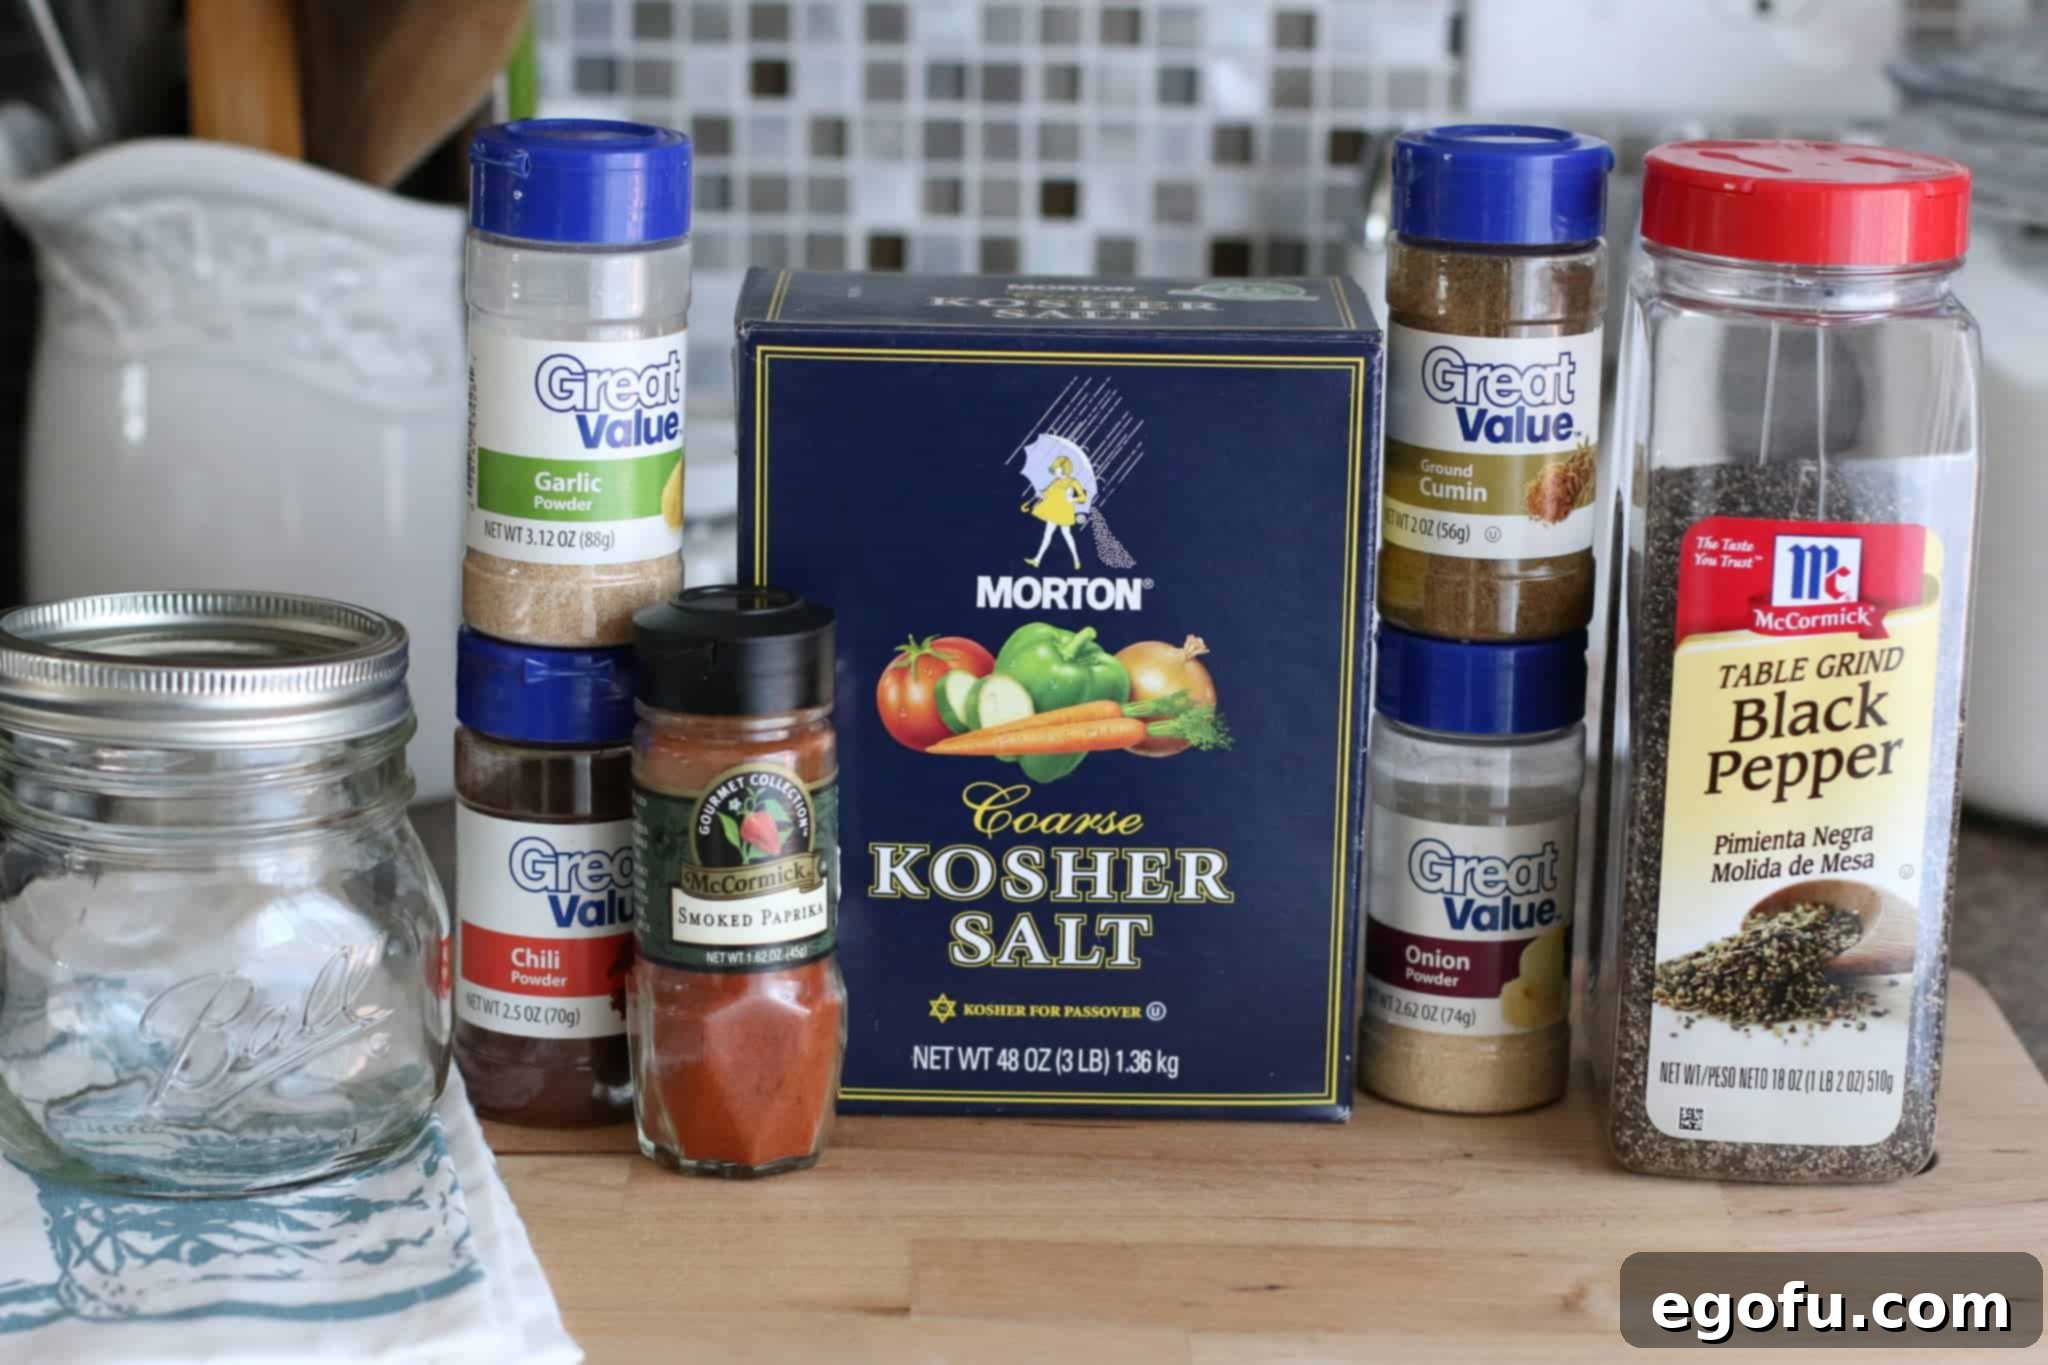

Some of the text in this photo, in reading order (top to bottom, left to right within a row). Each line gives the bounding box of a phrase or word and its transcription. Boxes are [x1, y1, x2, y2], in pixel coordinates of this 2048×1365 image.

[931, 296, 1225, 311] KOSHER
[992, 308, 1161, 320] SALT
[535, 350, 680, 412] Great
[1422, 346, 1576, 407] Great
[576, 409, 680, 449] Value
[1456, 406, 1575, 444] Value
[534, 471, 603, 493] Garlic
[1420, 459, 1473, 479] Ground
[533, 496, 593, 511] Powder
[1420, 477, 1487, 502] Cumin
[484, 520, 615, 550] NET WT 3.12 OZ (88g)
[1410, 515, 1417, 533] 2
[1419, 518, 1434, 536] OZ
[1437, 520, 1470, 544] (56g)
[1696, 536, 1754, 552] The Taste
[1694, 553, 1717, 566] You
[1753, 606, 1871, 631] McCormick
[1719, 646, 1905, 689] TABLE GRIND
[1729, 681, 1889, 743] Black
[1704, 738, 1903, 803] Pepper
[699, 776, 745, 835] GOURMET
[962, 781, 1145, 839] Coarse
[1713, 825, 1874, 855] Pimienta Negra
[509, 836, 634, 893] Grea
[868, 842, 1234, 903] KOSHER
[1408, 838, 1558, 898] Great
[1710, 852, 1874, 883] Molida de Mesa
[547, 890, 634, 928] Valu
[678, 902, 824, 927] SMOKED PAPRIKA
[1443, 896, 1557, 932] Value
[948, 910, 1153, 969] SALT
[511, 947, 560, 969] Chili
[706, 950, 725, 964] NET
[727, 951, 744, 964] WT
[769, 948, 782, 962] OZ
[1405, 945, 1470, 971] Onion
[511, 971, 568, 988] Powder
[1405, 968, 1459, 988] Powder
[482, 998, 500, 1016] WT
[503, 1002, 521, 1021] 2.5
[524, 1005, 541, 1023] OZ
[544, 1007, 581, 1028] (70g)
[963, 1003, 1142, 1018] KOSHER FOR PASSOVER
[1395, 997, 1419, 1018] 2.62
[1421, 1004, 1438, 1022] OZ
[1441, 1007, 1476, 1029] (74g)
[913, 1045, 1179, 1079] NET WT 48 OZ (3 LB) 1.36 kg
[1659, 1061, 1893, 1095] NET WT/PESO NETO 18 OZ (1 LB 2 OZ) 510g
